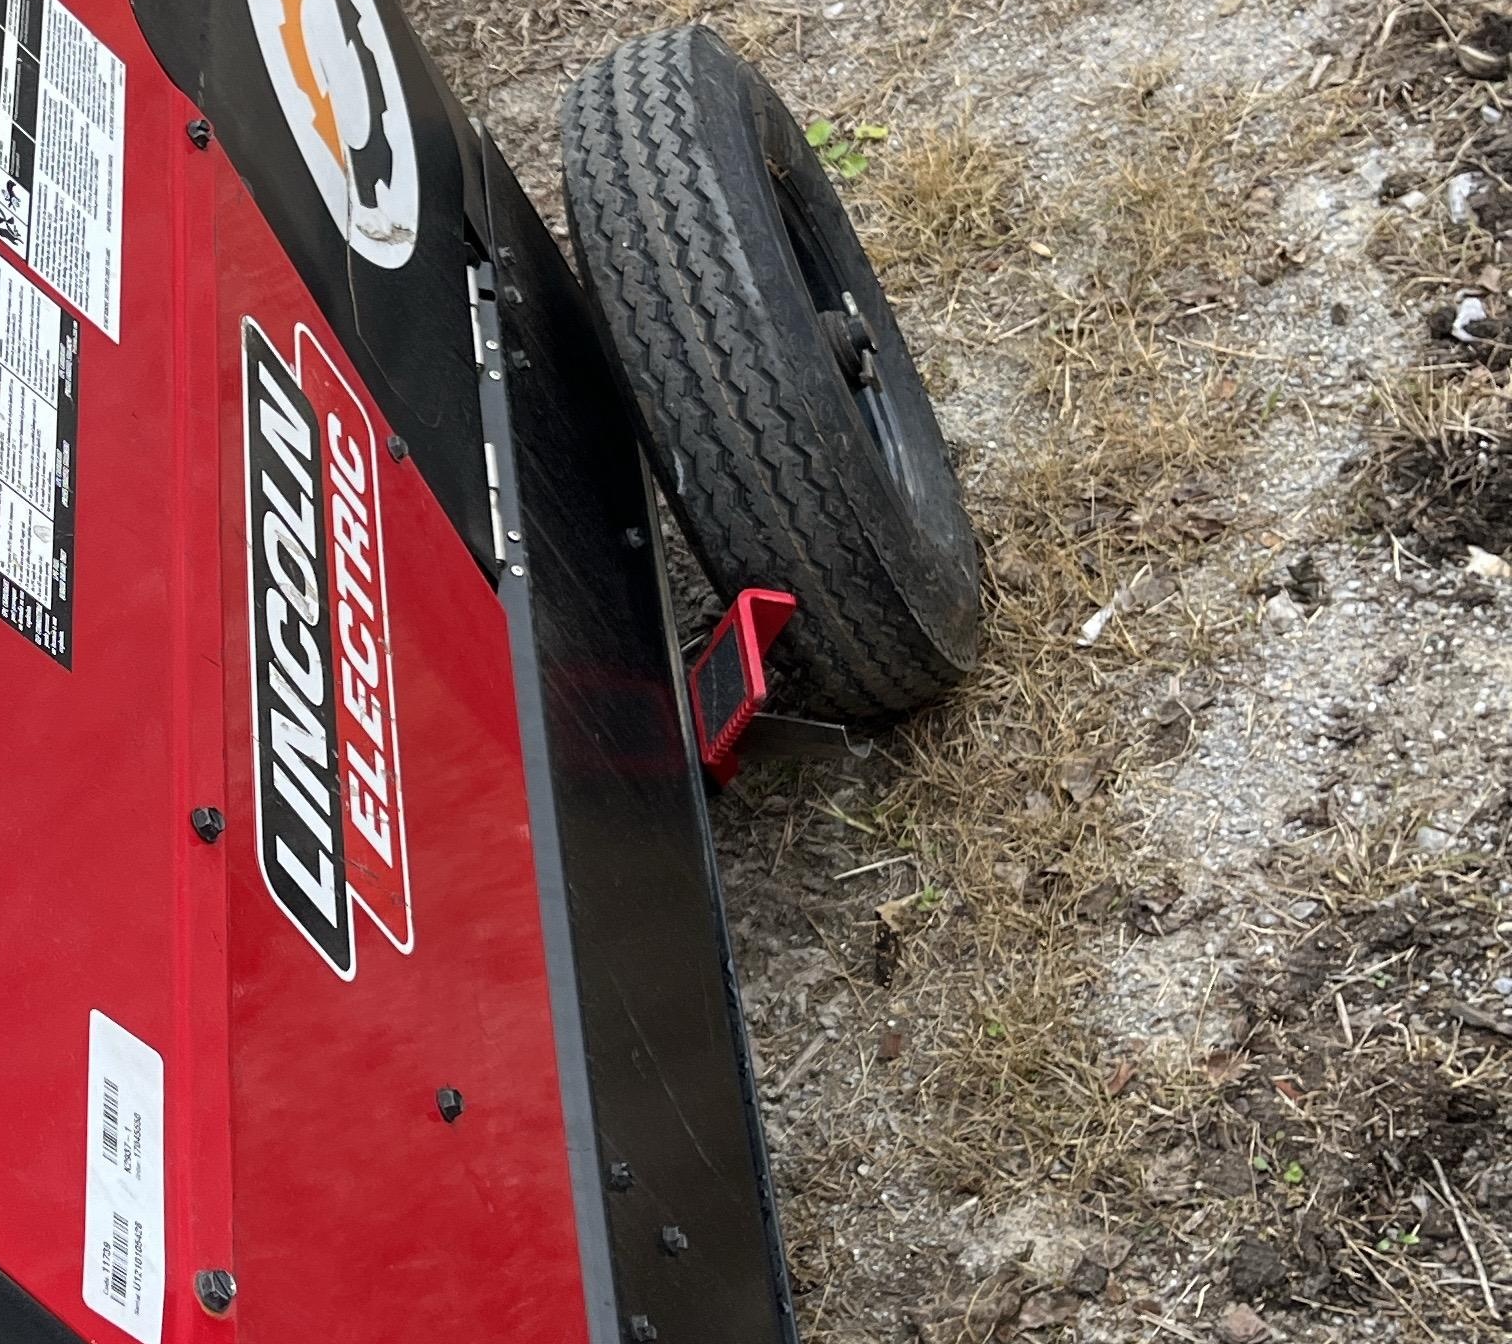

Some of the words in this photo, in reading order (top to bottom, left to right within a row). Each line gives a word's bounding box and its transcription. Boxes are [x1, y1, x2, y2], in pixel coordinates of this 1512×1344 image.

[257, 359, 339, 930] LINCOLN
[327, 411, 394, 870] ELECTRIC
[102, 1240, 111, 1273] 11739
